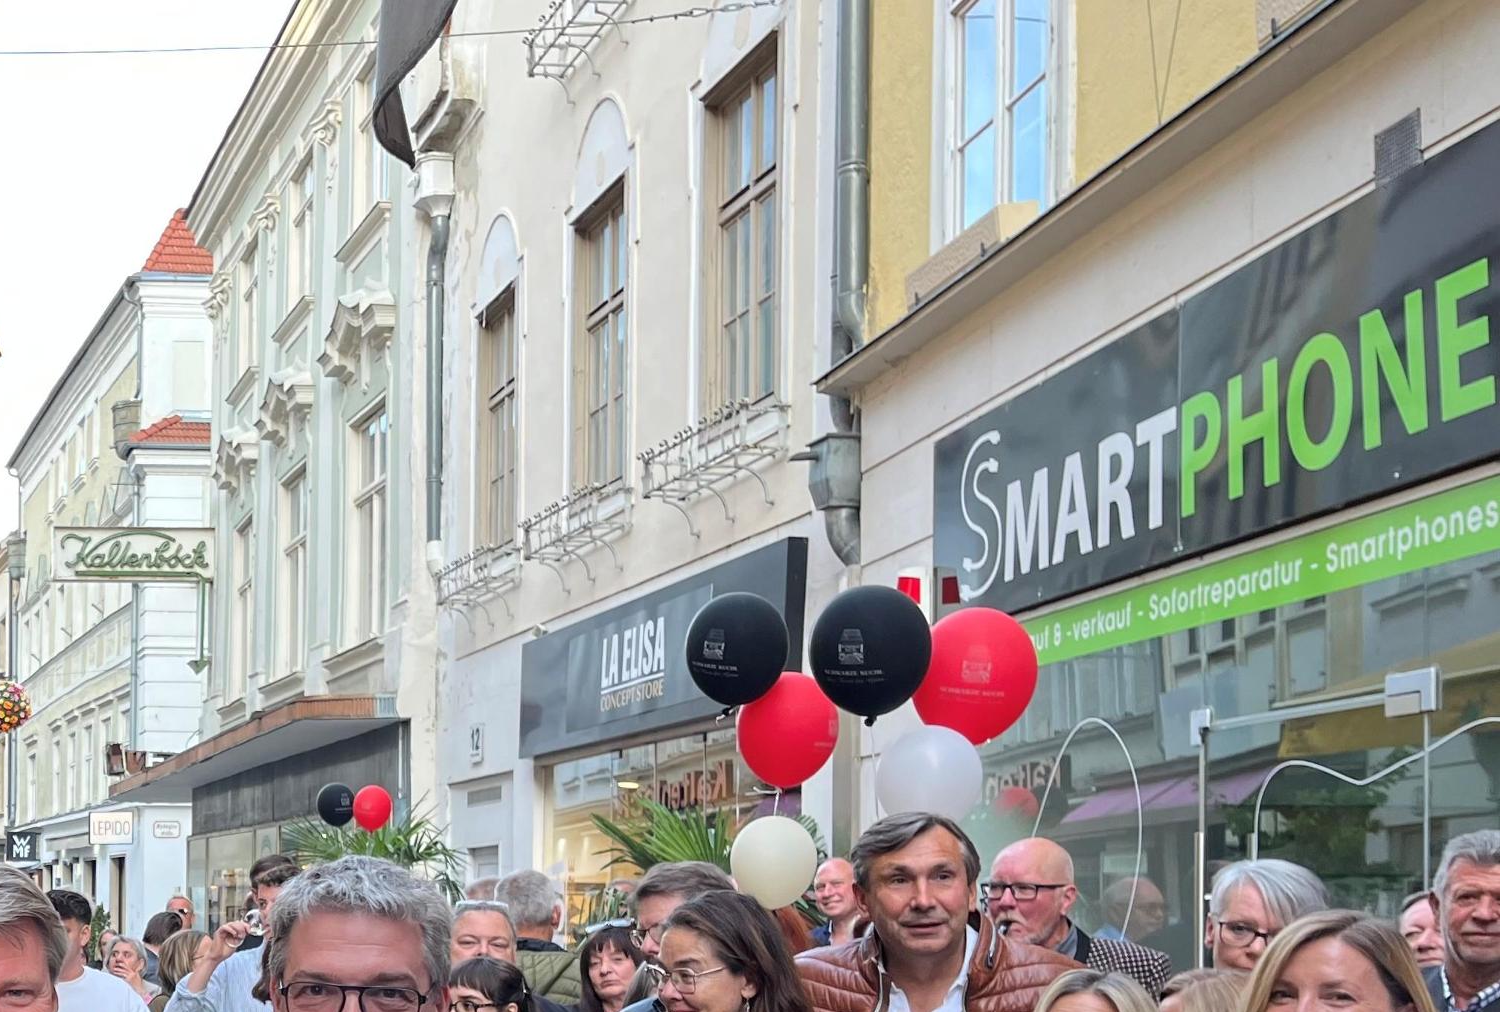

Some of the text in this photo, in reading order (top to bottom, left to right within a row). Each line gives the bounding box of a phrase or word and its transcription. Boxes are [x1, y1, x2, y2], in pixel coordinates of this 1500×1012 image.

[961, 257, 1496, 602] SMARTPHONE
[1031, 625, 1049, 651] uf
[1149, 558, 1303, 621] Sofortreparatur
[1325, 500, 1500, 573] Smartphones
[601, 616, 665, 689] LA ELISA
[601, 678, 665, 712] CONCEPT STORE
[471, 728, 480, 751] 12
[92, 820, 131, 836] LEPIDO
